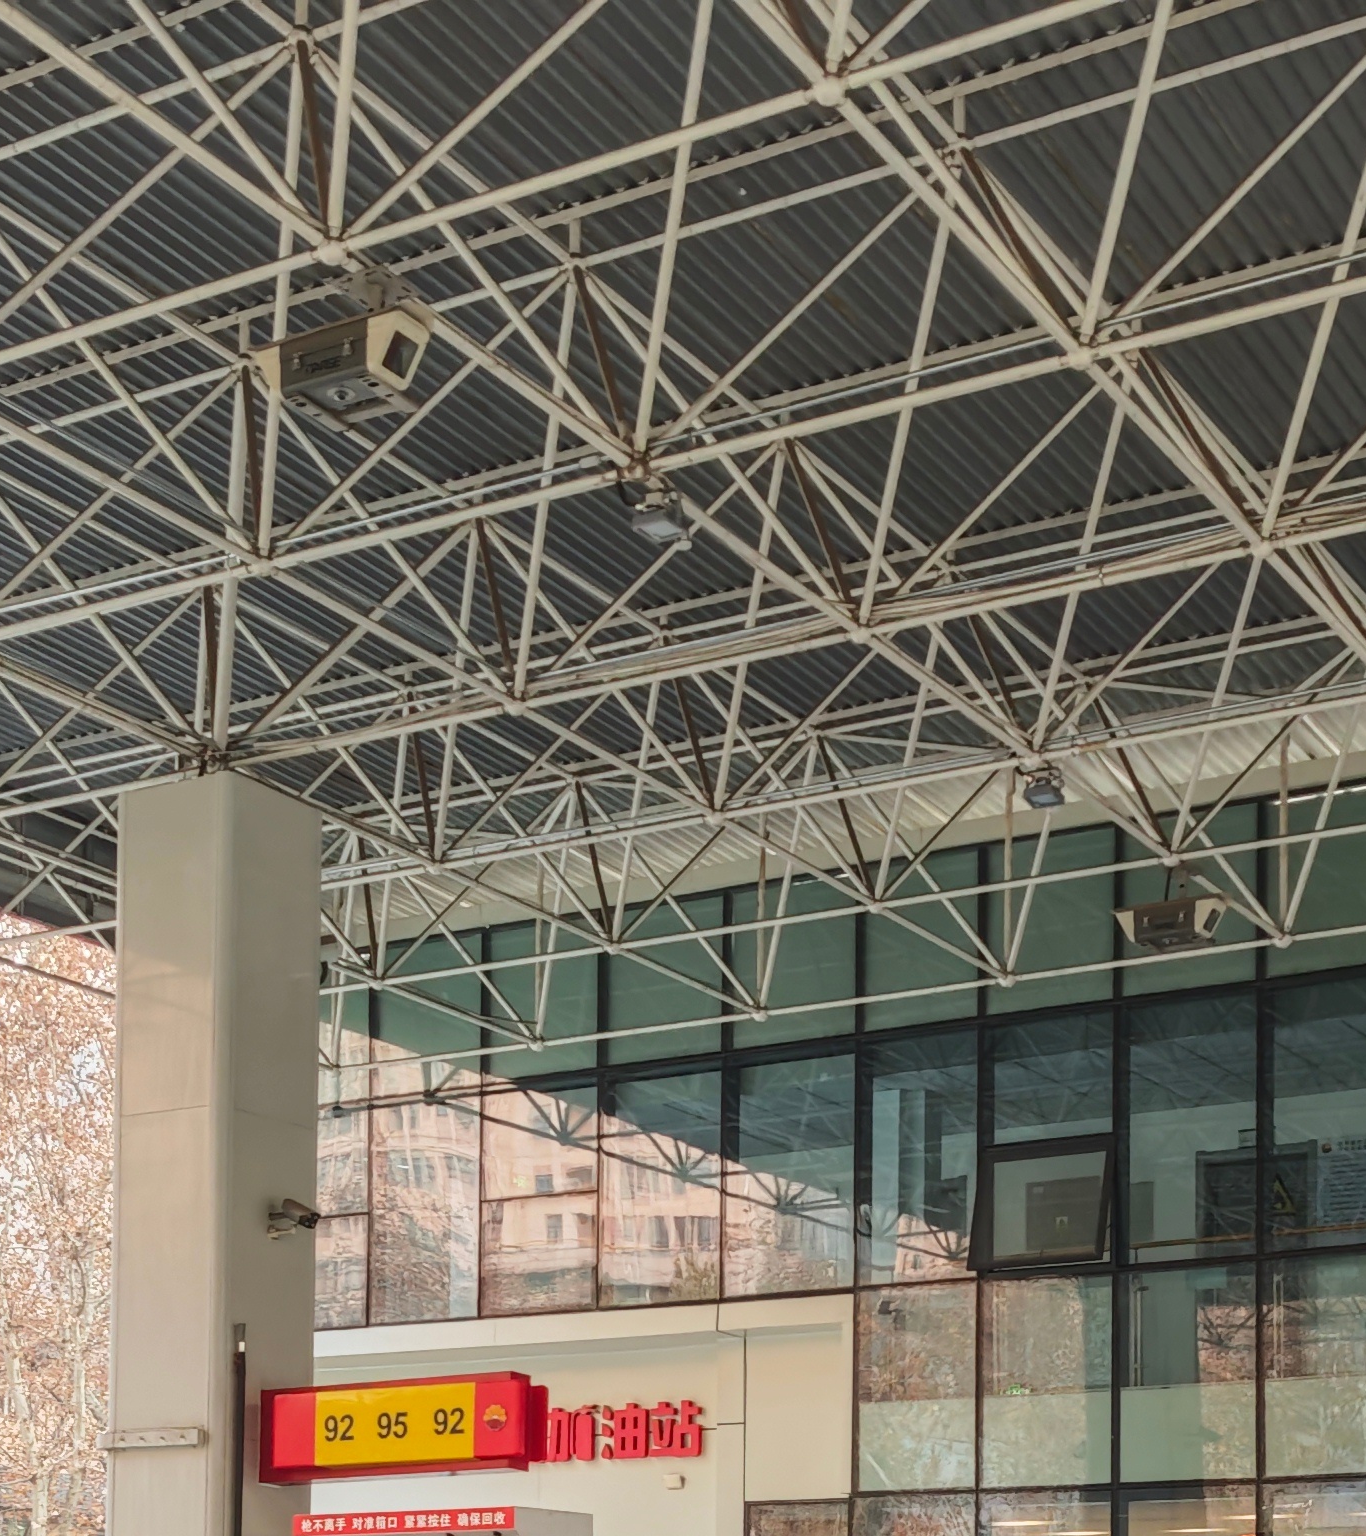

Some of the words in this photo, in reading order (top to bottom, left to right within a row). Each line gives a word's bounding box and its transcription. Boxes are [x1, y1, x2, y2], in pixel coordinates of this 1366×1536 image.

[324, 1414, 355, 1442] 92
[377, 1412, 409, 1439] 95
[433, 1407, 466, 1435] 92
[546, 1399, 704, 1462] 加油站
[301, 1517, 347, 1532] 枪不离手
[352, 1515, 398, 1531] 对准箱口
[404, 1513, 452, 1529] 紧紧按住
[457, 1511, 506, 1527] 确保回收
